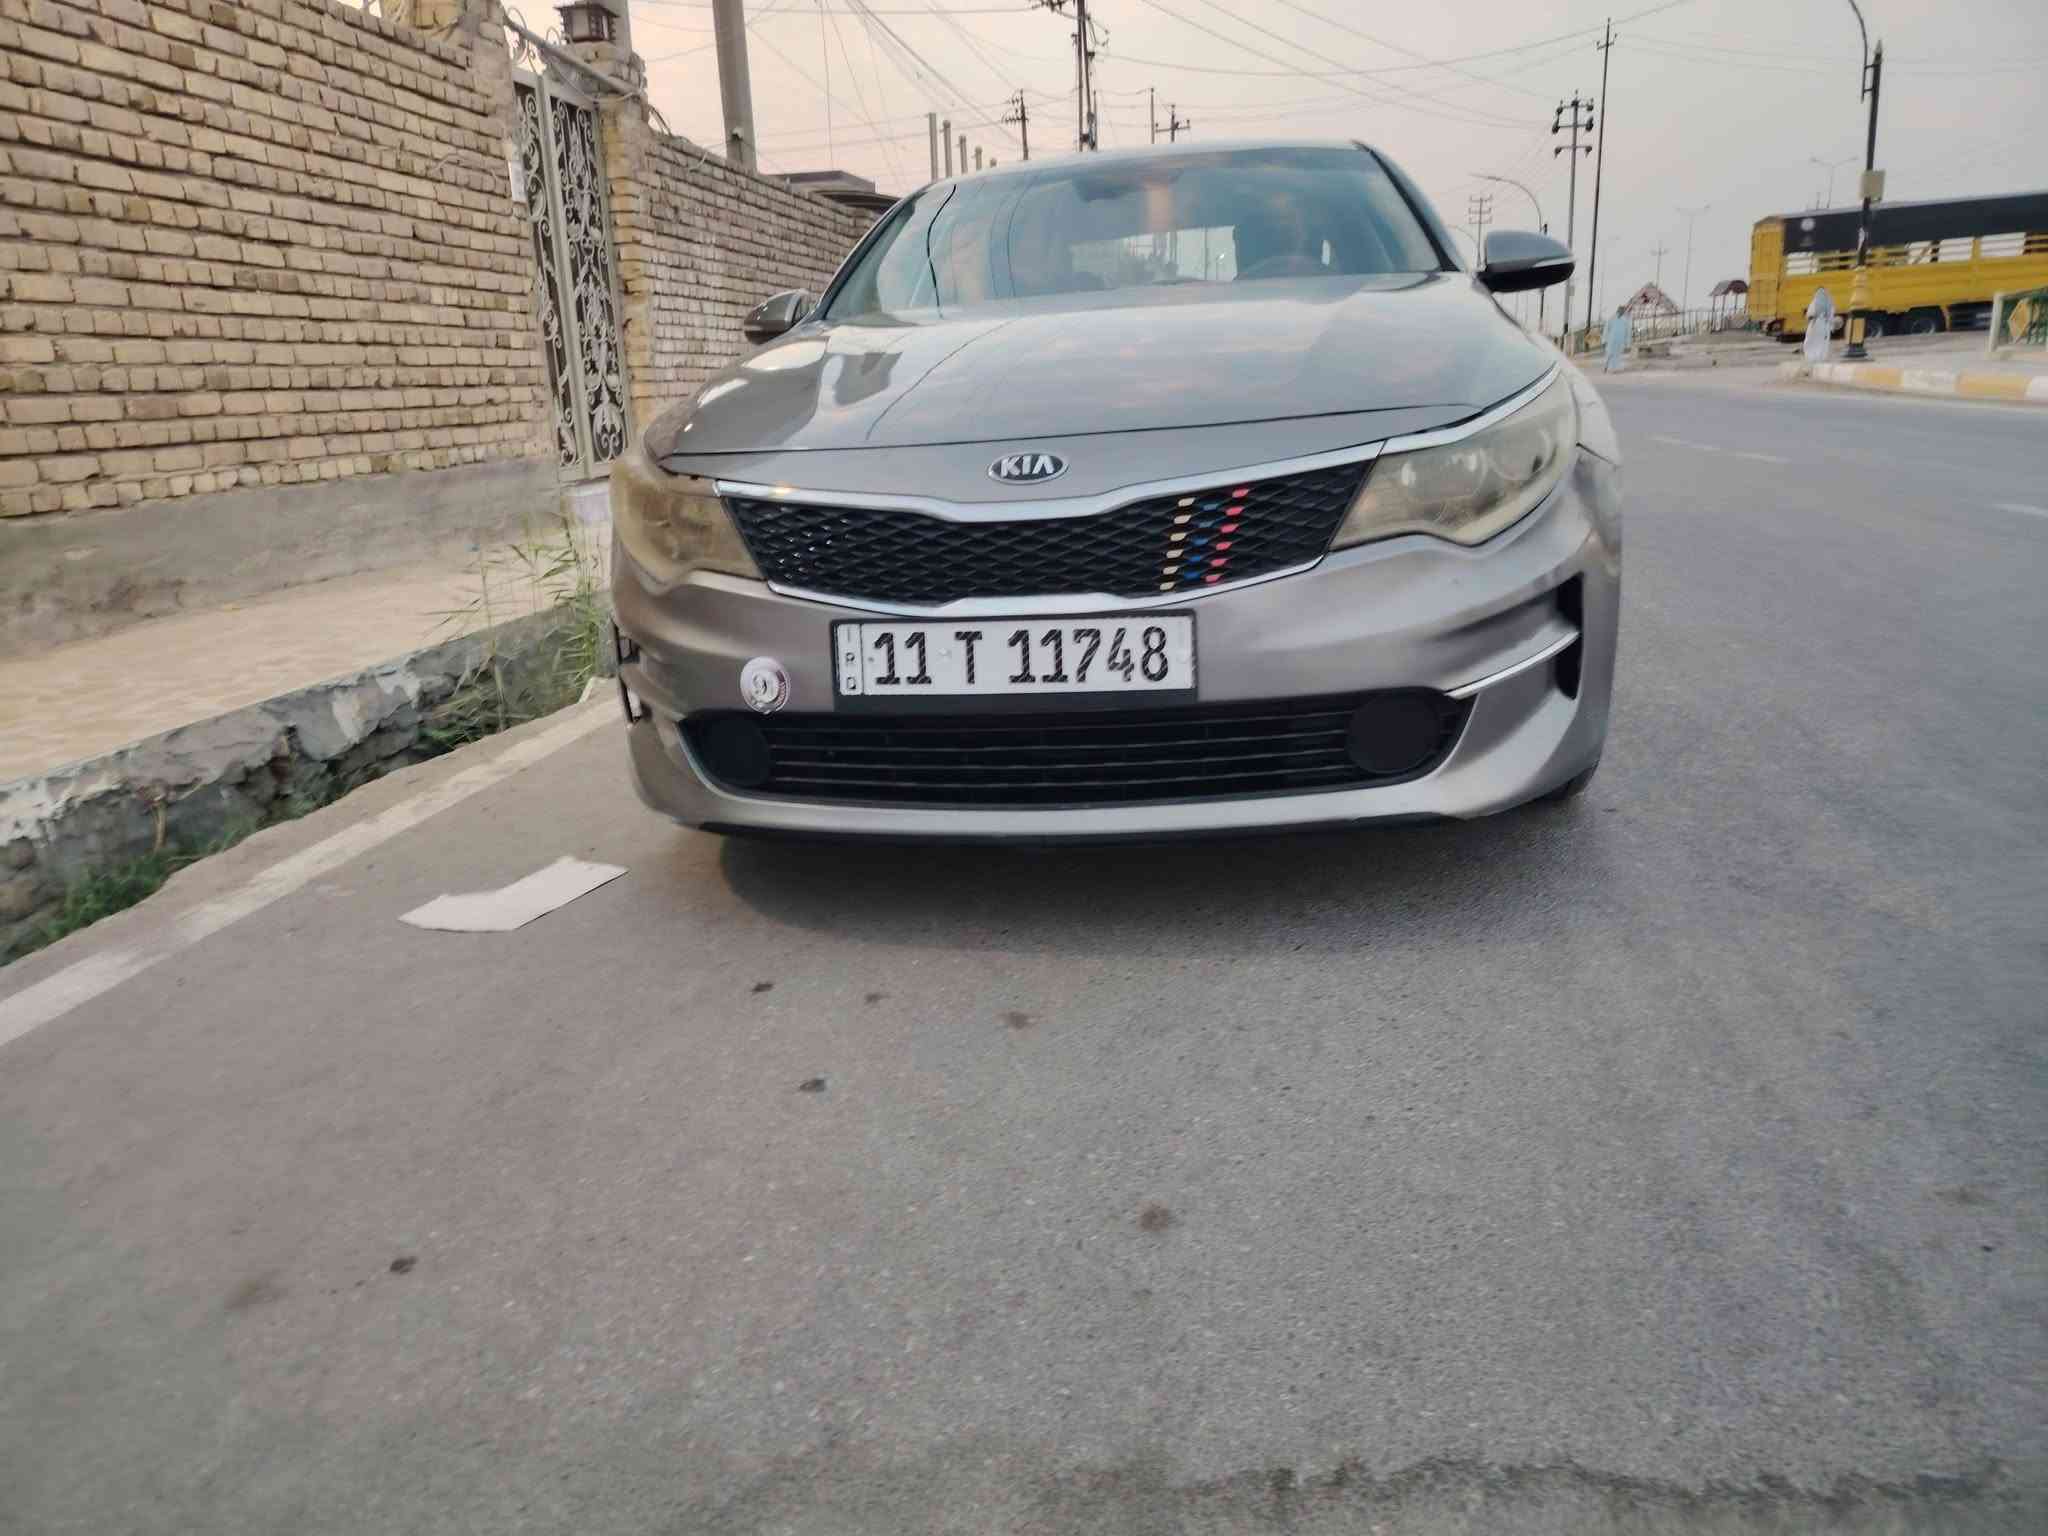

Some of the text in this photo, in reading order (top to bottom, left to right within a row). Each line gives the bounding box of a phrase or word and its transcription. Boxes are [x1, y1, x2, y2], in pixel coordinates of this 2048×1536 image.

[1000, 455, 1055, 478] KIA
[874, 626, 1168, 684] 11 T 11748
